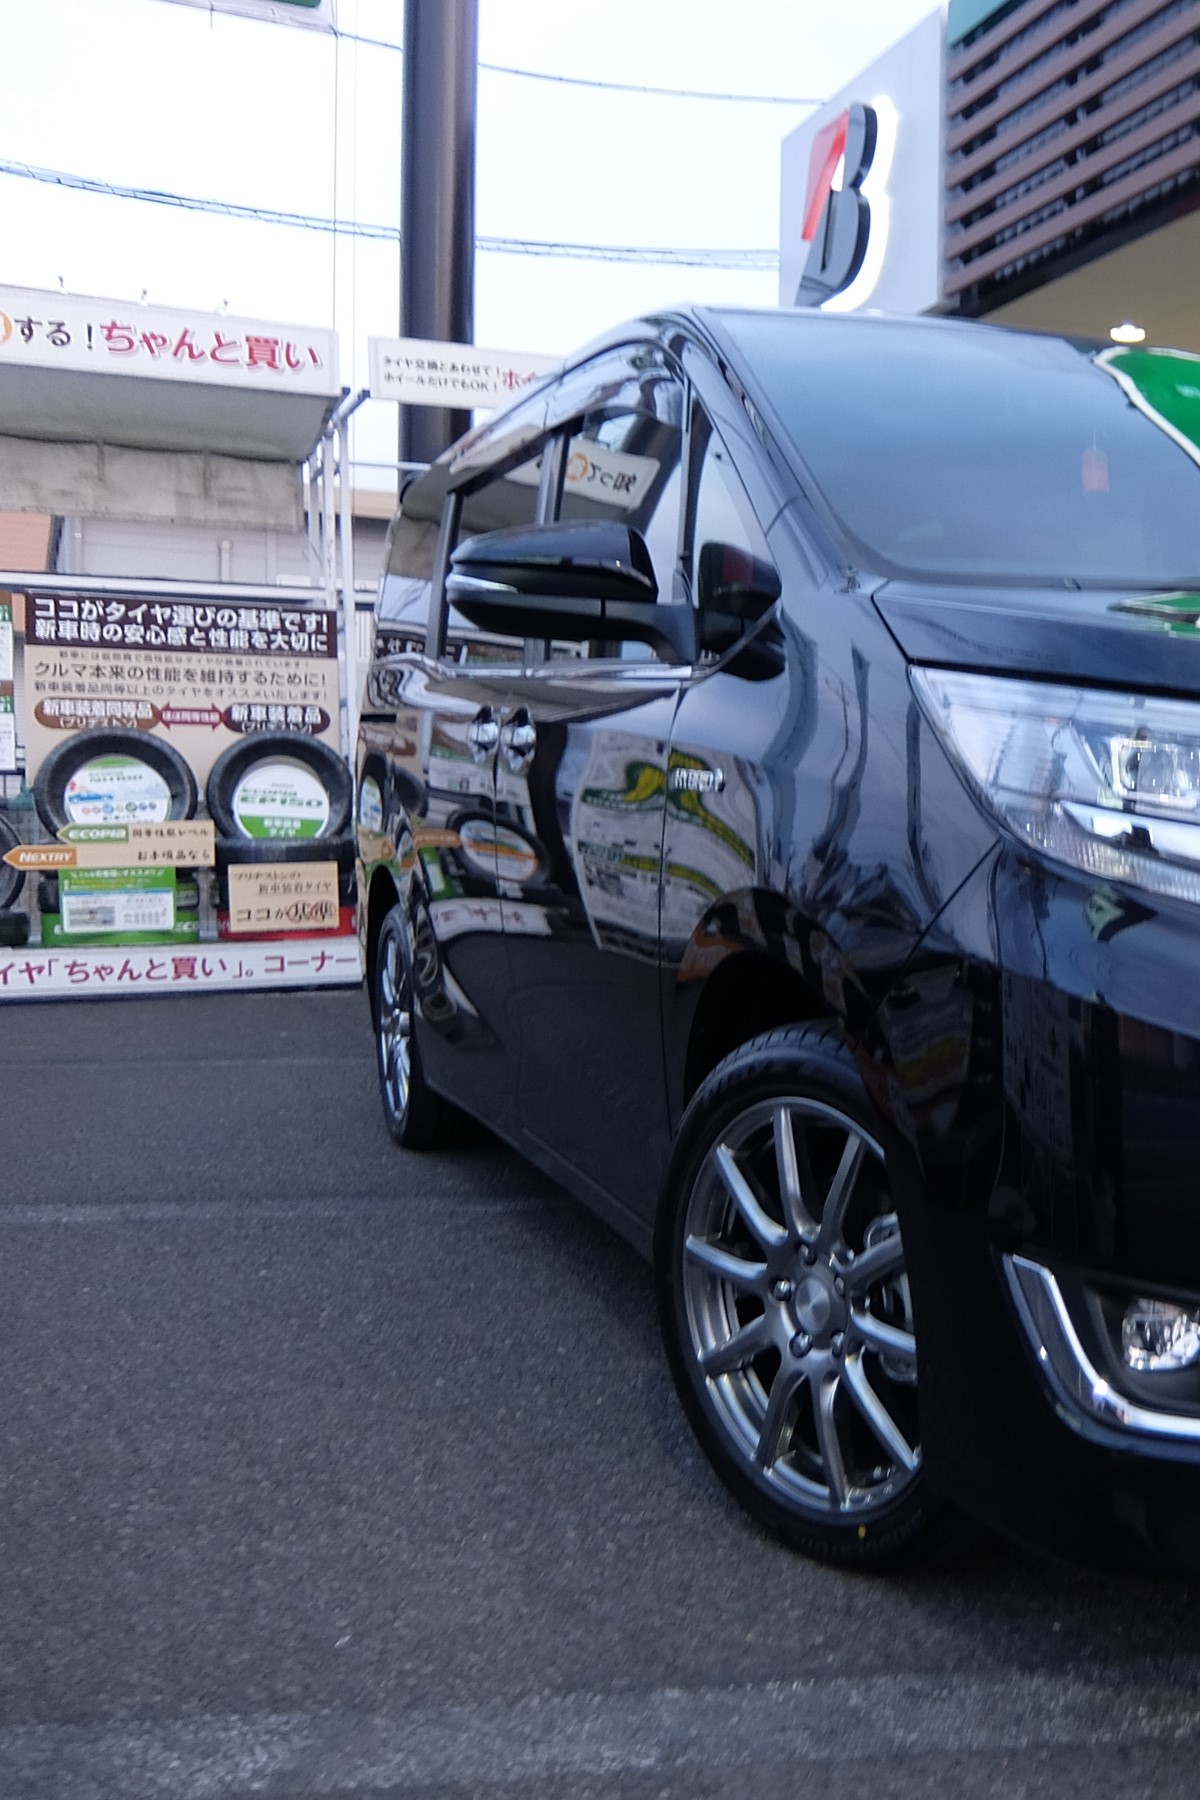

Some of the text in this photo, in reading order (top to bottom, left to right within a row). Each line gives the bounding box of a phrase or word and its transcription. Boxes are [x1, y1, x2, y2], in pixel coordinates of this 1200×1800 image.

[34, 598, 328, 633] ココがタイヤ選びの基準です!
[34, 619, 328, 651] 新車時の安心感と性能を大切に
[34, 662, 326, 686] クルマ本来の性能を維持するために!
[43, 698, 153, 719] 新車装着同等品
[231, 704, 321, 724] 新車装着品
[19, 850, 211, 864] NEXTRY お手頃品なら
